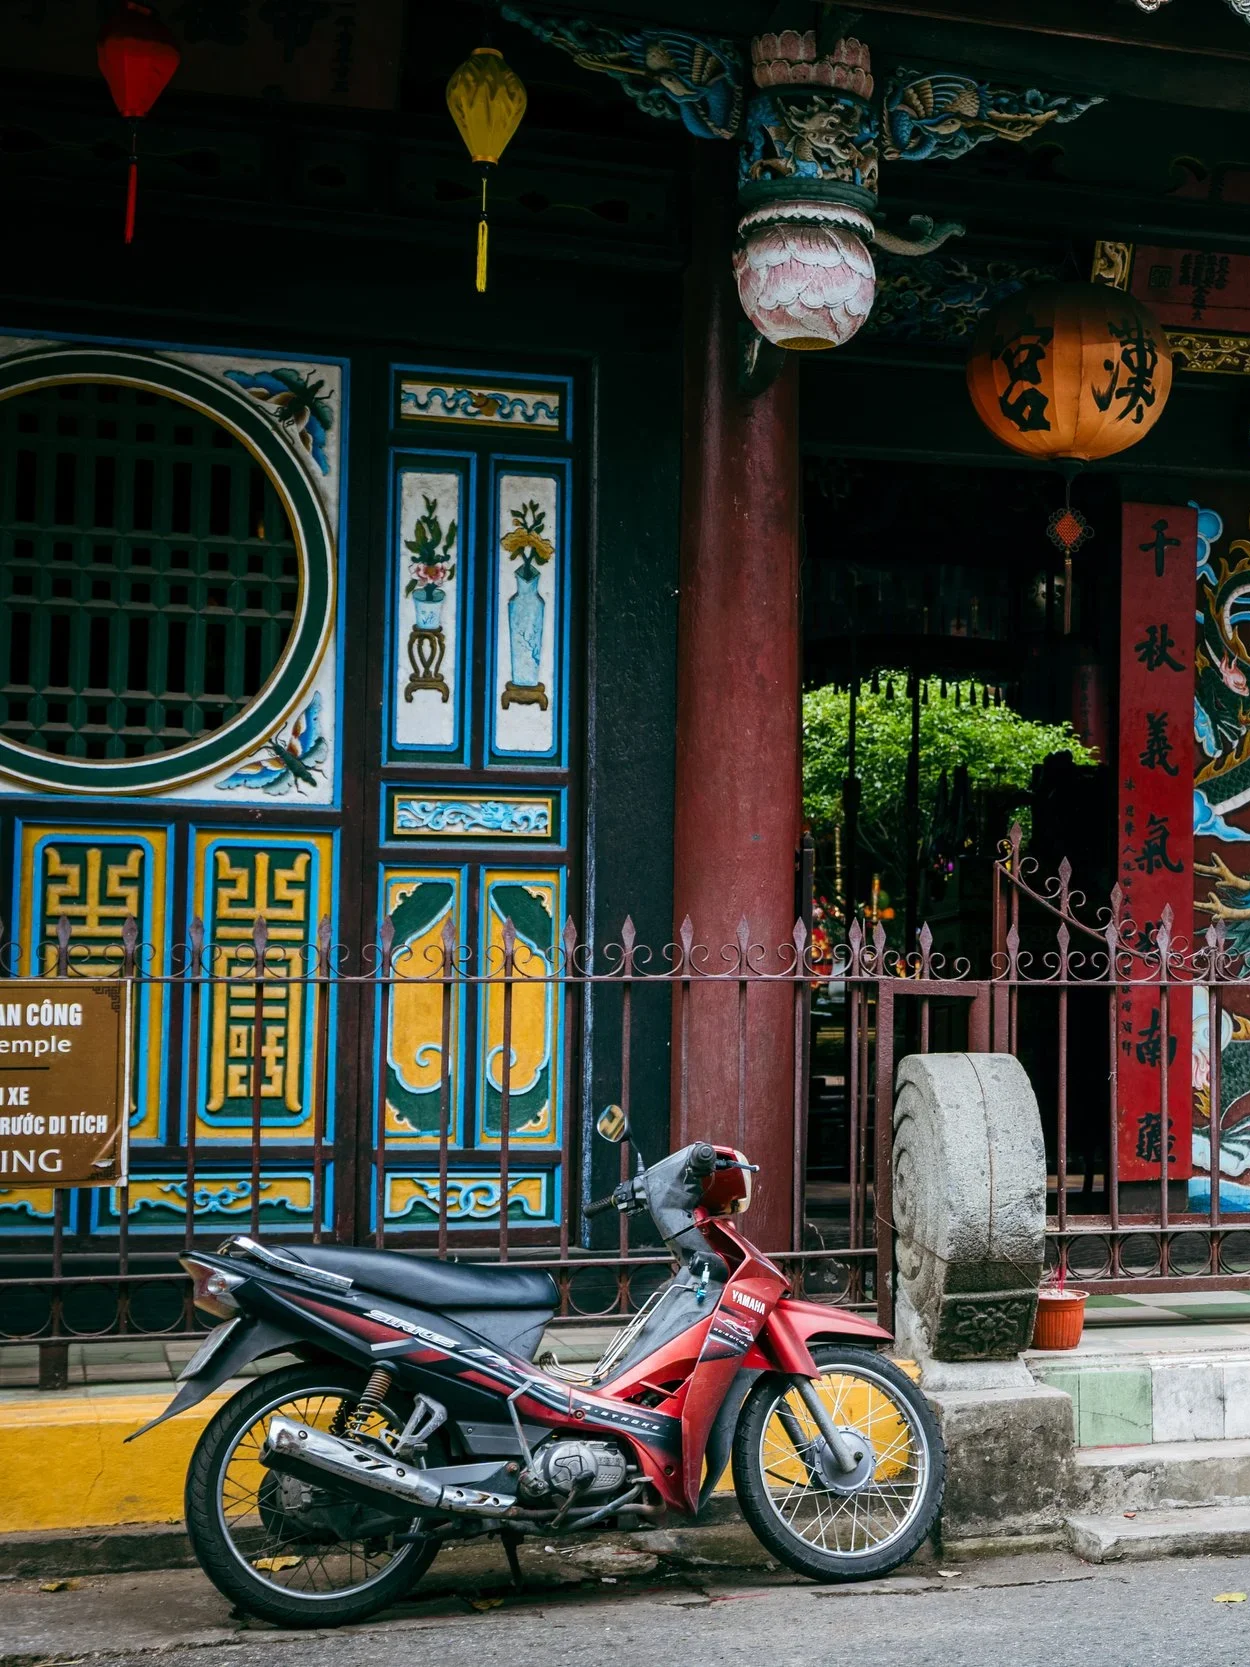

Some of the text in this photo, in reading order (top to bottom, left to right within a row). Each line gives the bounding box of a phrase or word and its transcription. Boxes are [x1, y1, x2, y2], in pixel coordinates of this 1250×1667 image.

[26, 999, 83, 1027] CÔNG
[7, 1086, 30, 1106] XE
[49, 1116, 66, 1134] DI
[70, 1111, 108, 1134] TÍCH
[0, 1149, 63, 1173] ING
[732, 1289, 766, 1315] YAMAHA
[363, 1309, 462, 1348] SIRIUS
